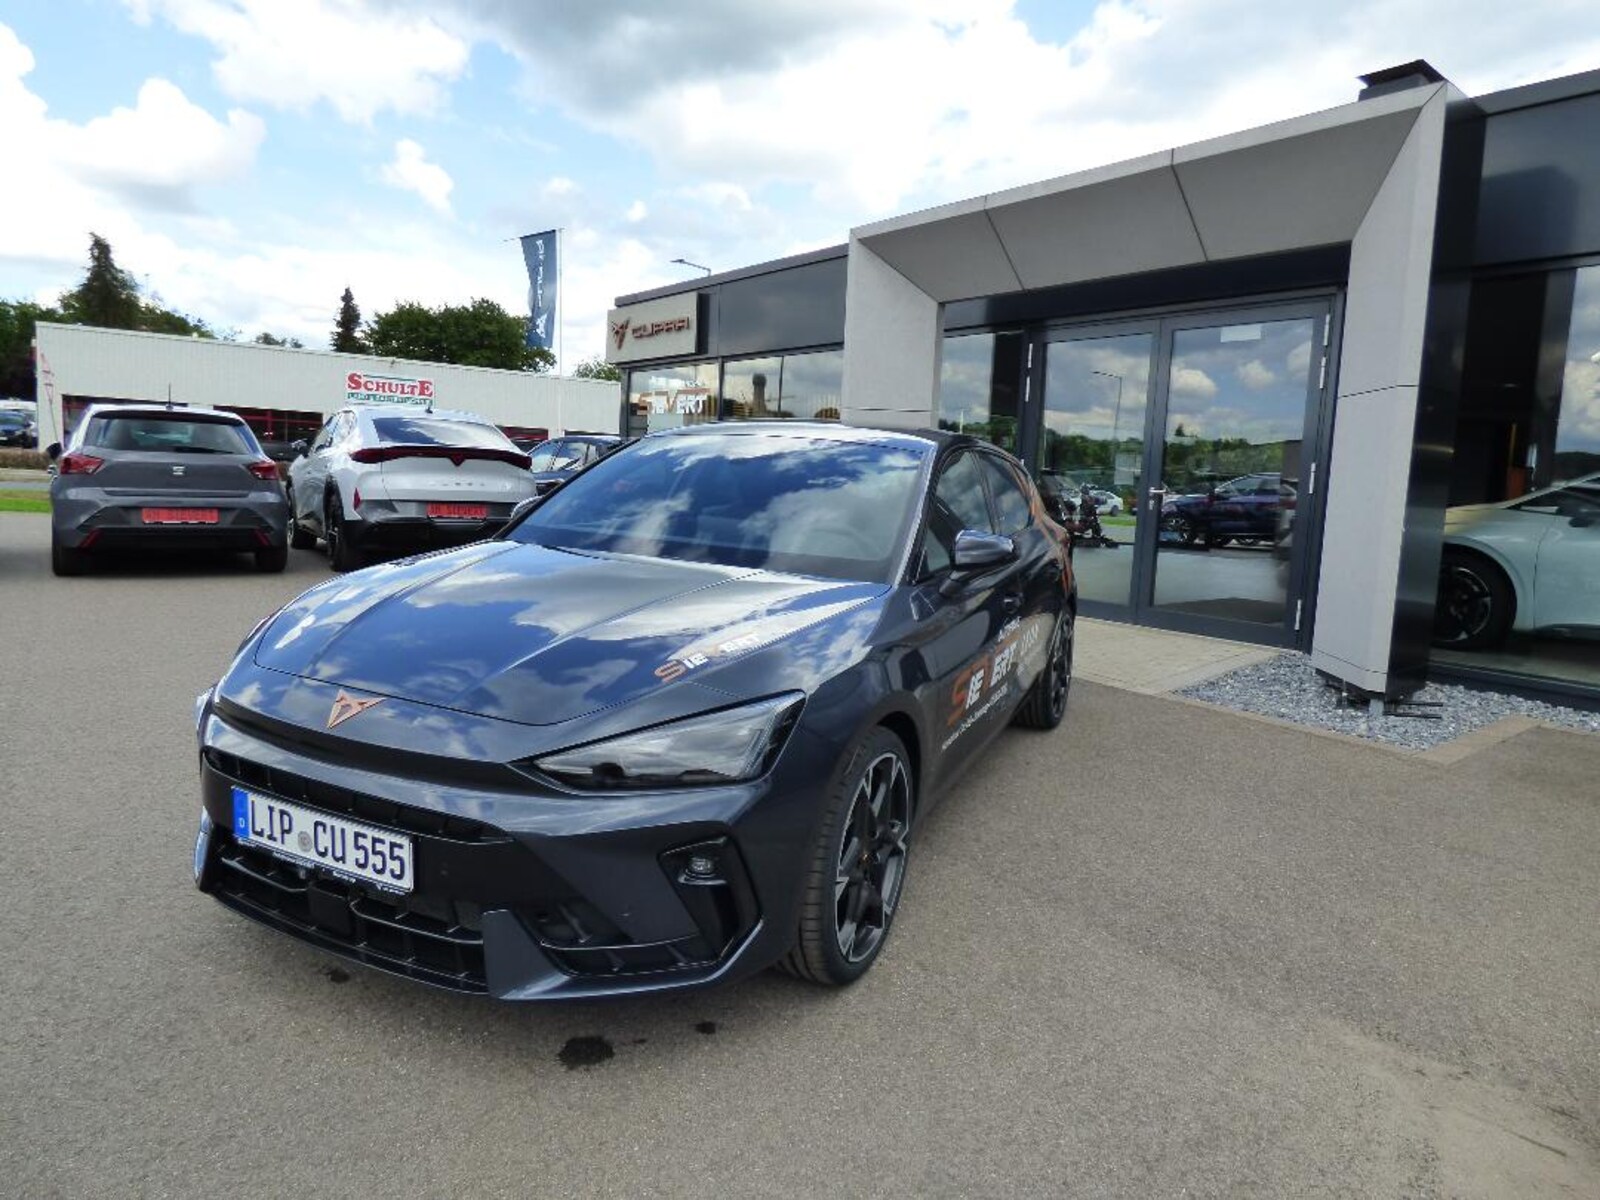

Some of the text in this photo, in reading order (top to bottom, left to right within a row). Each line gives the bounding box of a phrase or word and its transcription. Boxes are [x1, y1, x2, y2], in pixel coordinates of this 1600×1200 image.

[632, 317, 690, 339] CUPRA
[637, 387, 710, 416] SIEVERT
[251, 799, 293, 845] LIP
[313, 820, 347, 864] CU
[354, 831, 406, 881] 555
